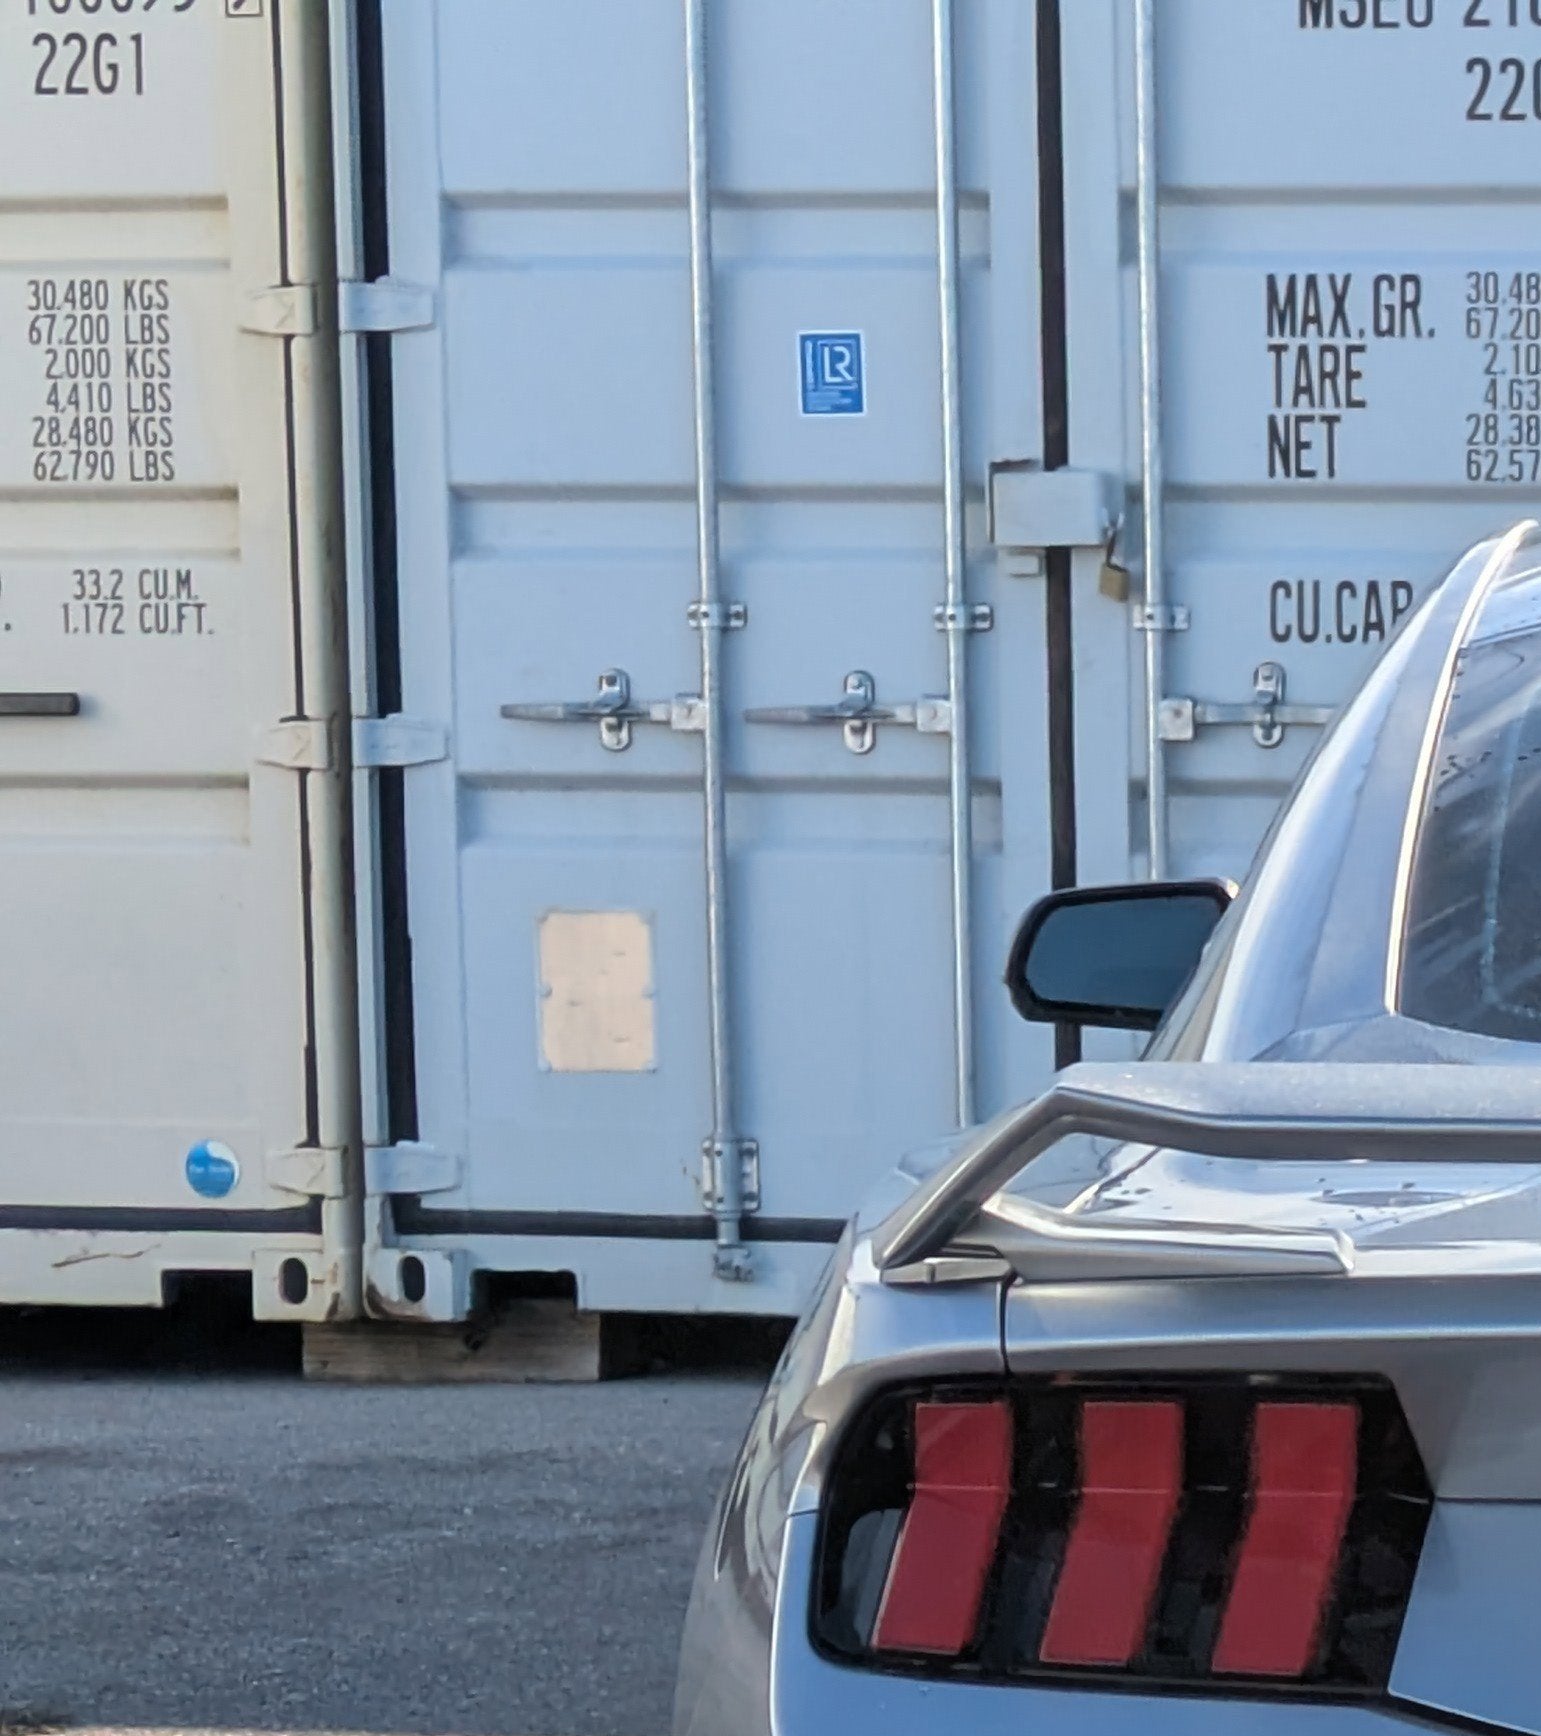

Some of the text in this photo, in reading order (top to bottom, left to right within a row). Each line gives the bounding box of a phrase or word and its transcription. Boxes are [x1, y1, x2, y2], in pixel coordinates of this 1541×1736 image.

[32, 32, 143, 96] 22G1
[26, 279, 170, 312] 30.480 KGS
[1265, 272, 1437, 339] MAX.GR.
[27, 313, 171, 346] 67.200 LBS
[44, 347, 172, 380] 2.000 KGS
[1267, 343, 1367, 409] TARE
[45, 381, 173, 414] 4.410 LBS
[31, 415, 174, 448] 28.480 KGS
[1267, 413, 1342, 480] NET
[32, 449, 176, 482] 62.790 LBS
[72, 568, 199, 601] 33.2 CU.M.
[62, 602, 216, 635] 1.172 CU.FT.
